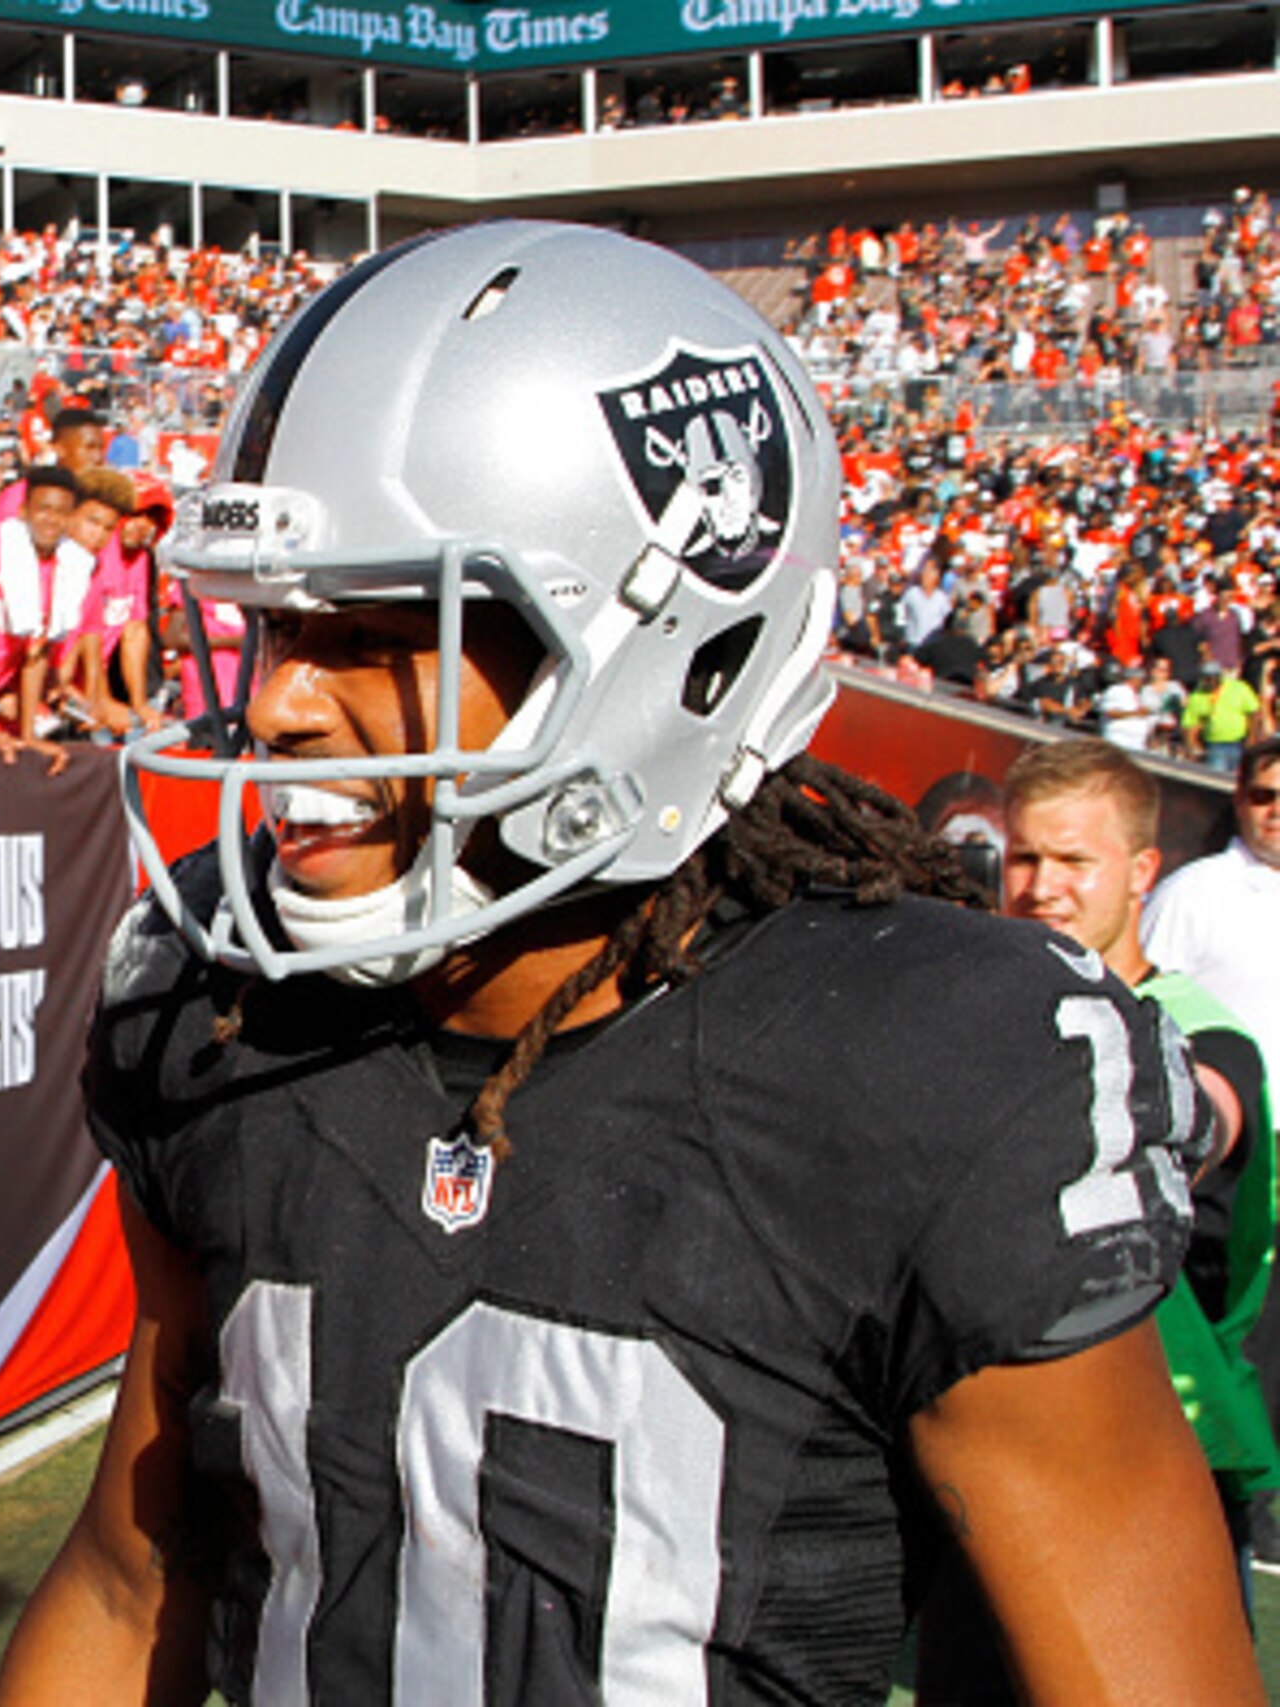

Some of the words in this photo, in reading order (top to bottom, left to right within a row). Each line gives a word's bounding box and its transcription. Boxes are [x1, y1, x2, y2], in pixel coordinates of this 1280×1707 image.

[406, 4, 478, 61] Bay
[483, 8, 608, 52] Times
[620, 362, 760, 420] RAIDERS
[433, 1176, 478, 1214] NFL
[220, 1278, 726, 1707] 10
